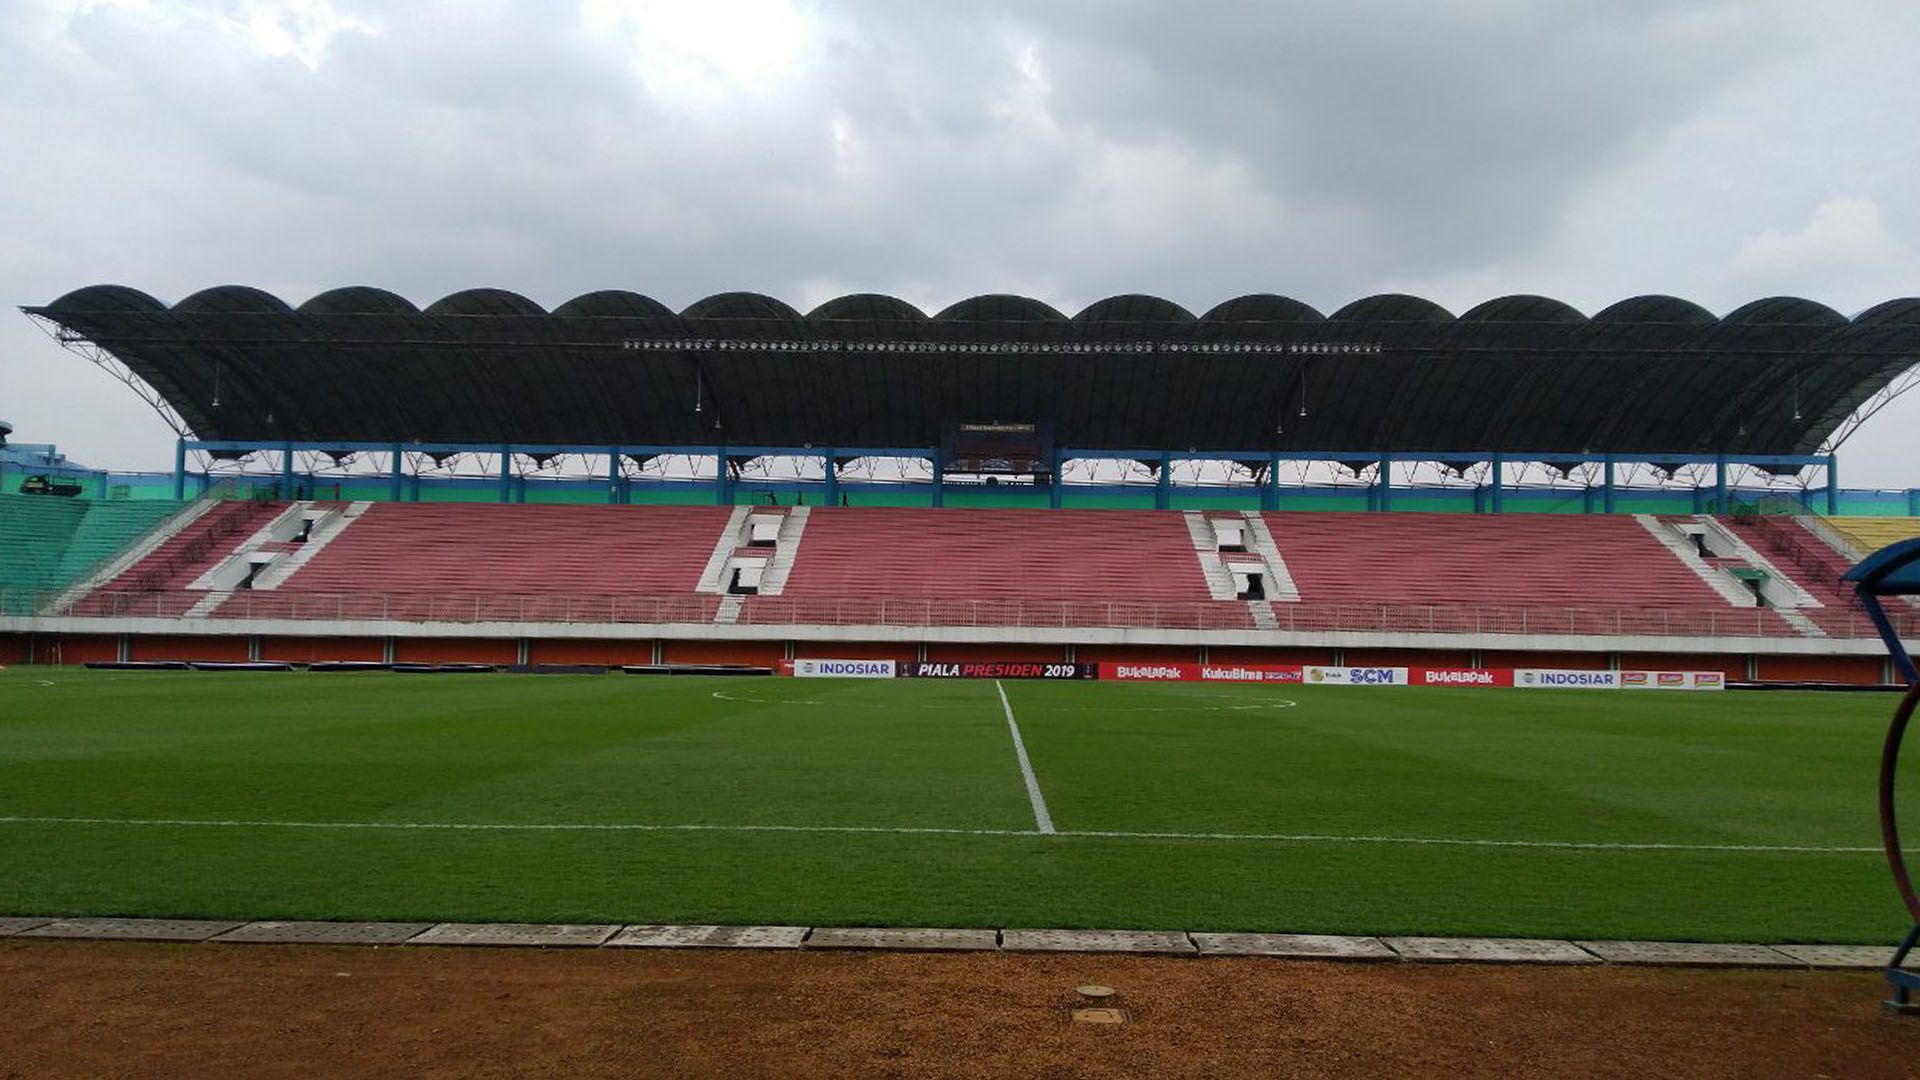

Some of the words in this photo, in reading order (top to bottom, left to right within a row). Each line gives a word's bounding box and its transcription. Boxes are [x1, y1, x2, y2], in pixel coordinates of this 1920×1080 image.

[820, 663, 889, 674] INDOSIAR
[918, 664, 960, 676] PIALA
[963, 664, 1042, 676] PRESIDEN
[1044, 665, 1075, 677] 2019
[1350, 669, 1394, 683] SCM
[1541, 673, 1614, 684] INDOSIAR
